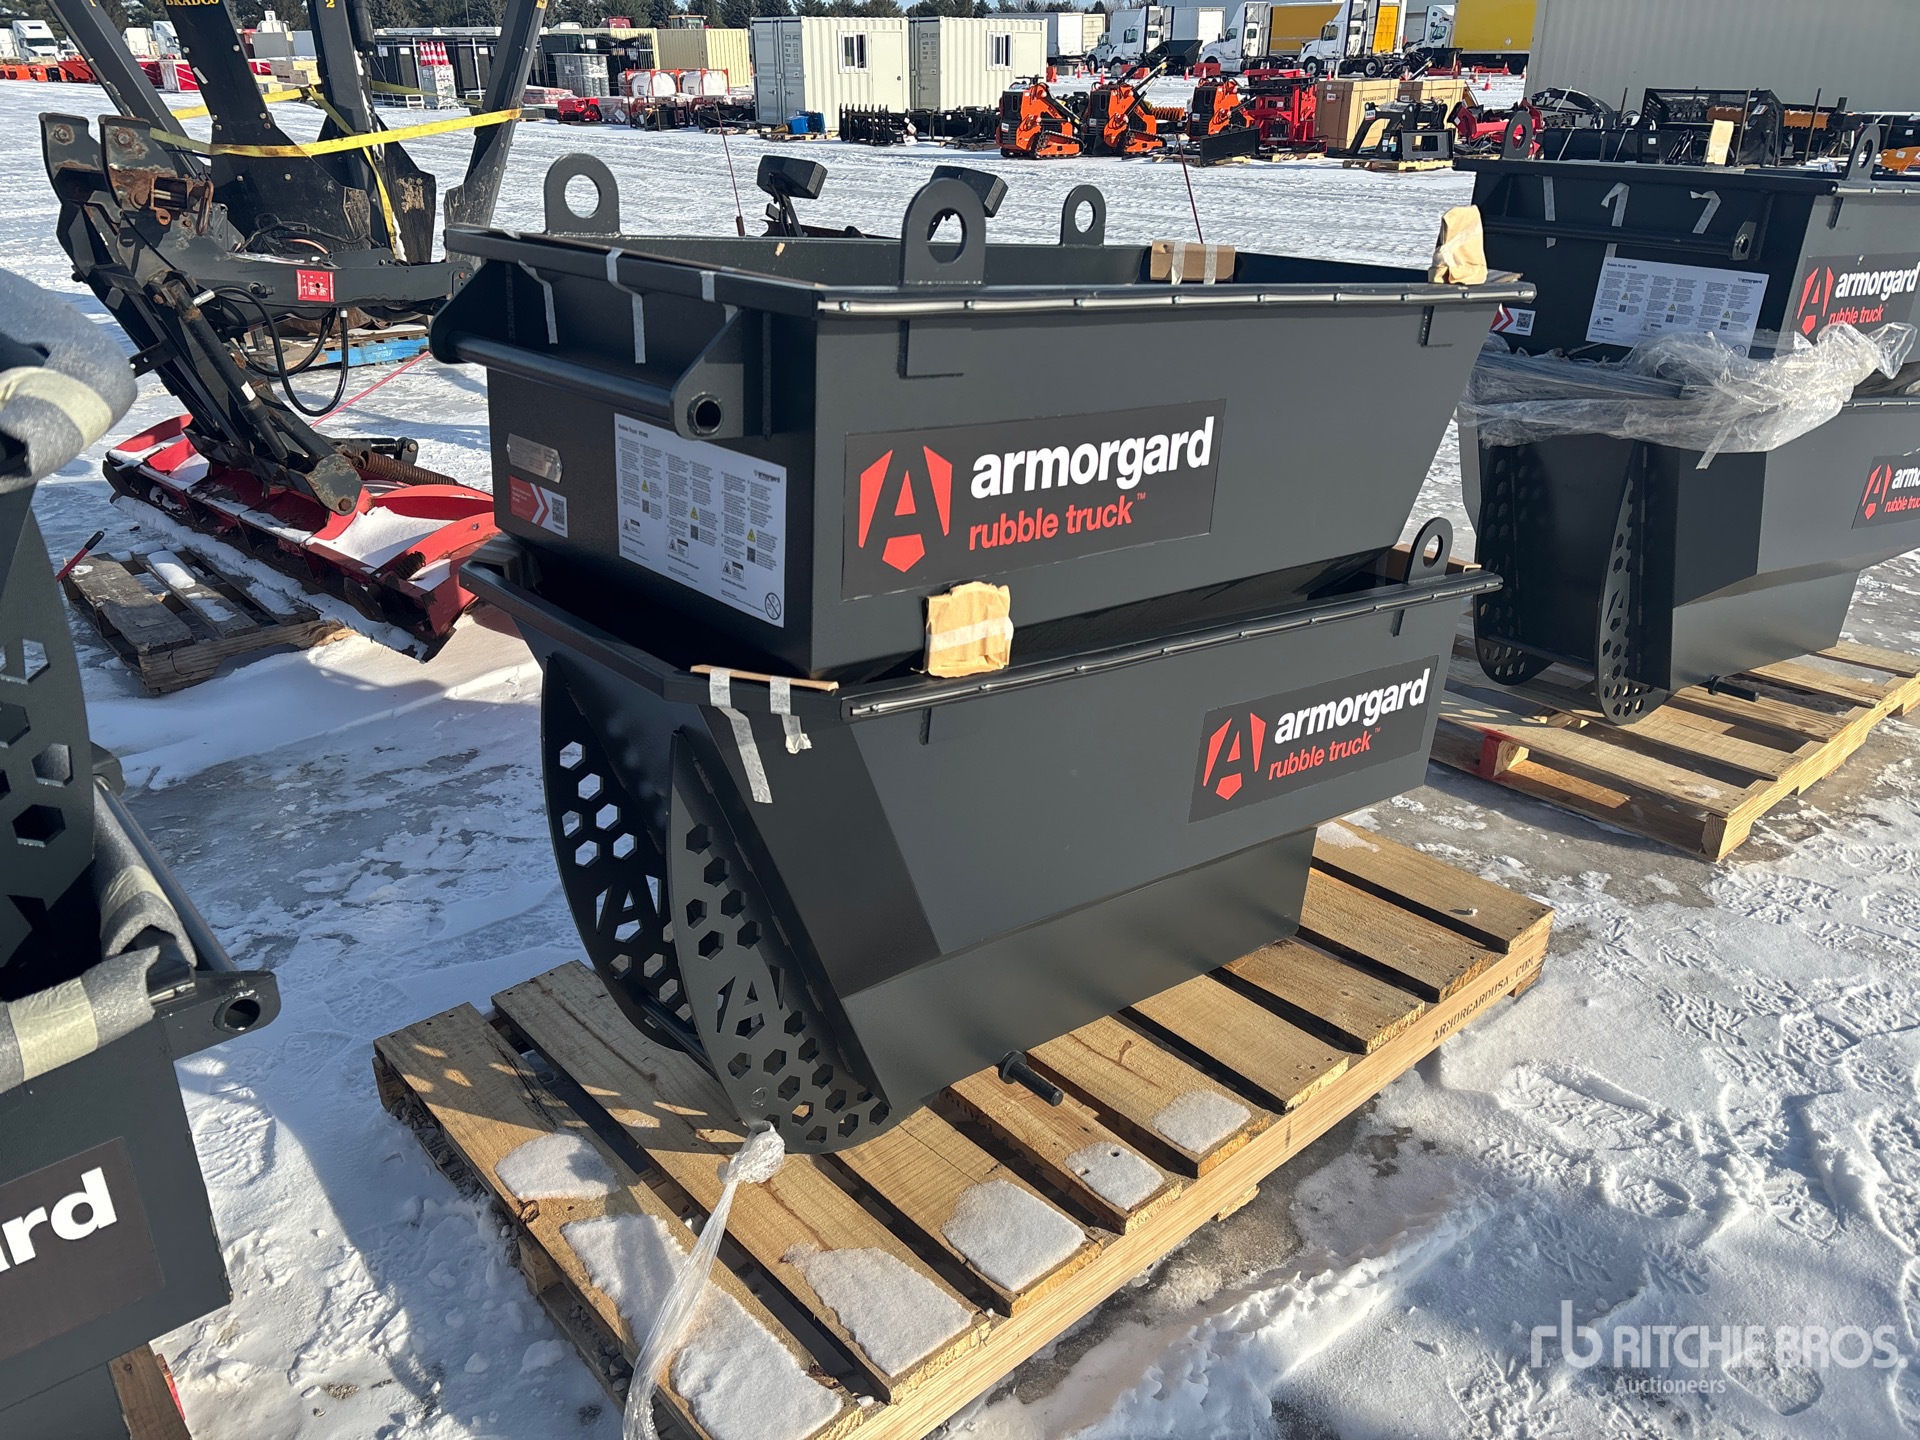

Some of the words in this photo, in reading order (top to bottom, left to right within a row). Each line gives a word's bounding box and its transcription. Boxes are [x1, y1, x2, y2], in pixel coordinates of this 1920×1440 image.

[1835, 260, 1920, 301] armorgard
[1859, 304, 1884, 323] truck
[970, 416, 1214, 499] armorgard
[969, 504, 1059, 550] rubble
[1065, 495, 1133, 533] truck
[1274, 668, 1431, 744] armorgard
[1268, 745, 1325, 780] rubble
[1329, 730, 1372, 762] truck
[0, 1166, 118, 1273] rd
